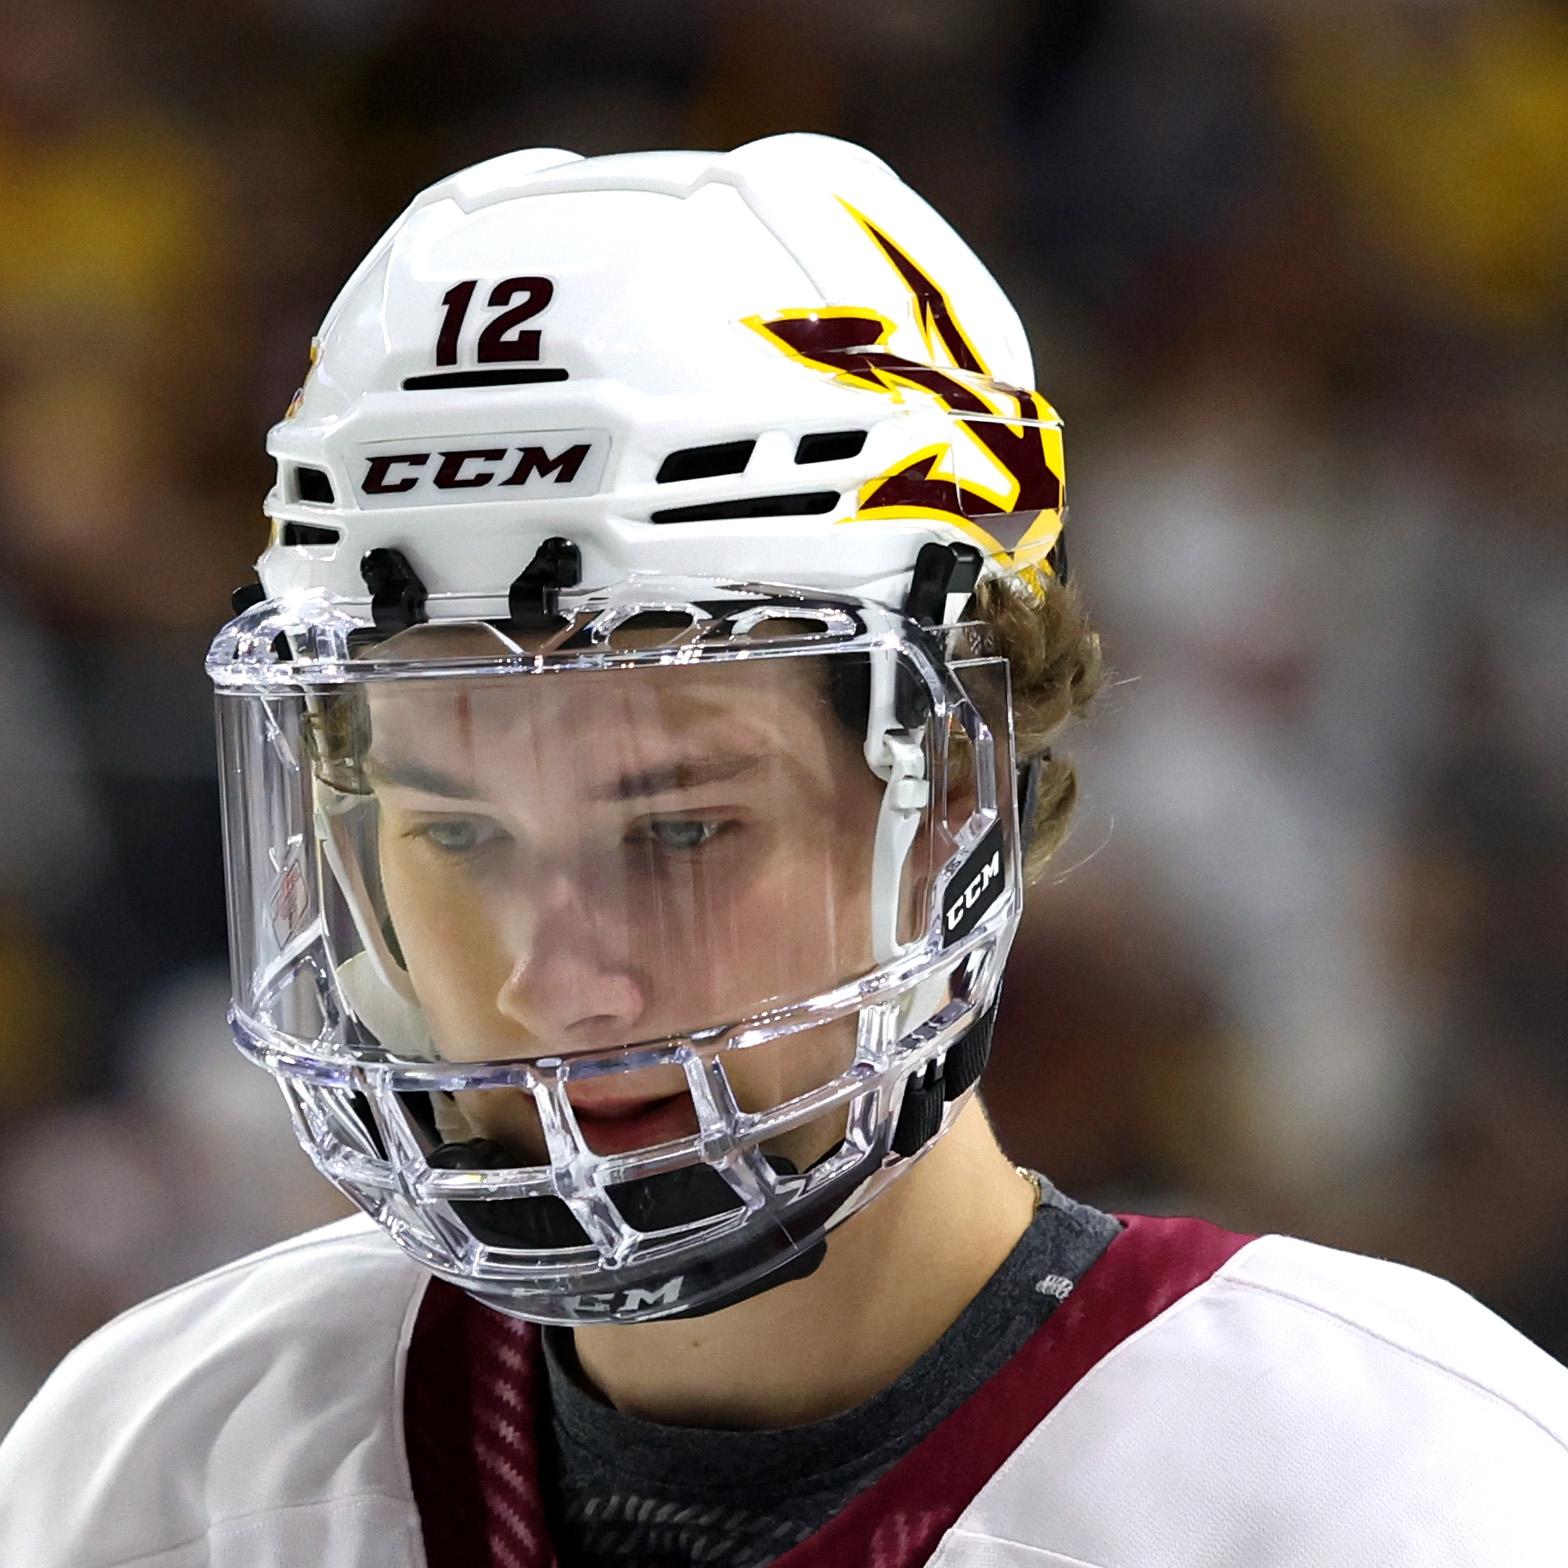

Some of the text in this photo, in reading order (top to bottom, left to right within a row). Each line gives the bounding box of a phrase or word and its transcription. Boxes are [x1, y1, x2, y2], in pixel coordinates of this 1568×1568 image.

[436, 276, 554, 366] 12
[361, 444, 592, 494] CCM
[946, 850, 1000, 931] CCM
